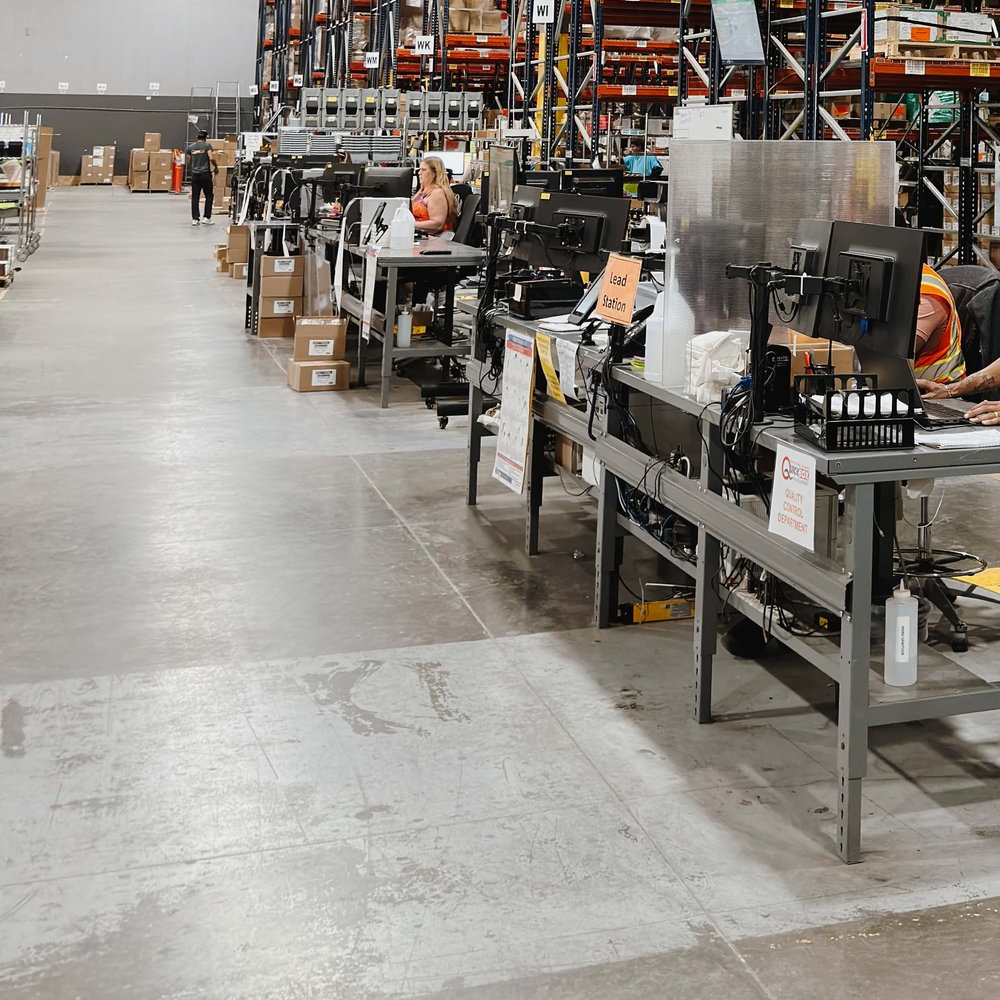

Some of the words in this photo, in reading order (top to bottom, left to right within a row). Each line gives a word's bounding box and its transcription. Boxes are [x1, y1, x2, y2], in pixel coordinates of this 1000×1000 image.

[537, 5, 548, 16] WI
[418, 40, 430, 50] WK
[367, 56, 378, 64] WM
[610, 272, 628, 286] Lead
[602, 294, 626, 312] Station
[785, 488, 804, 503] QUALITY
[783, 502, 804, 518] CONTROL
[778, 513, 808, 534] DEPARTMENT
